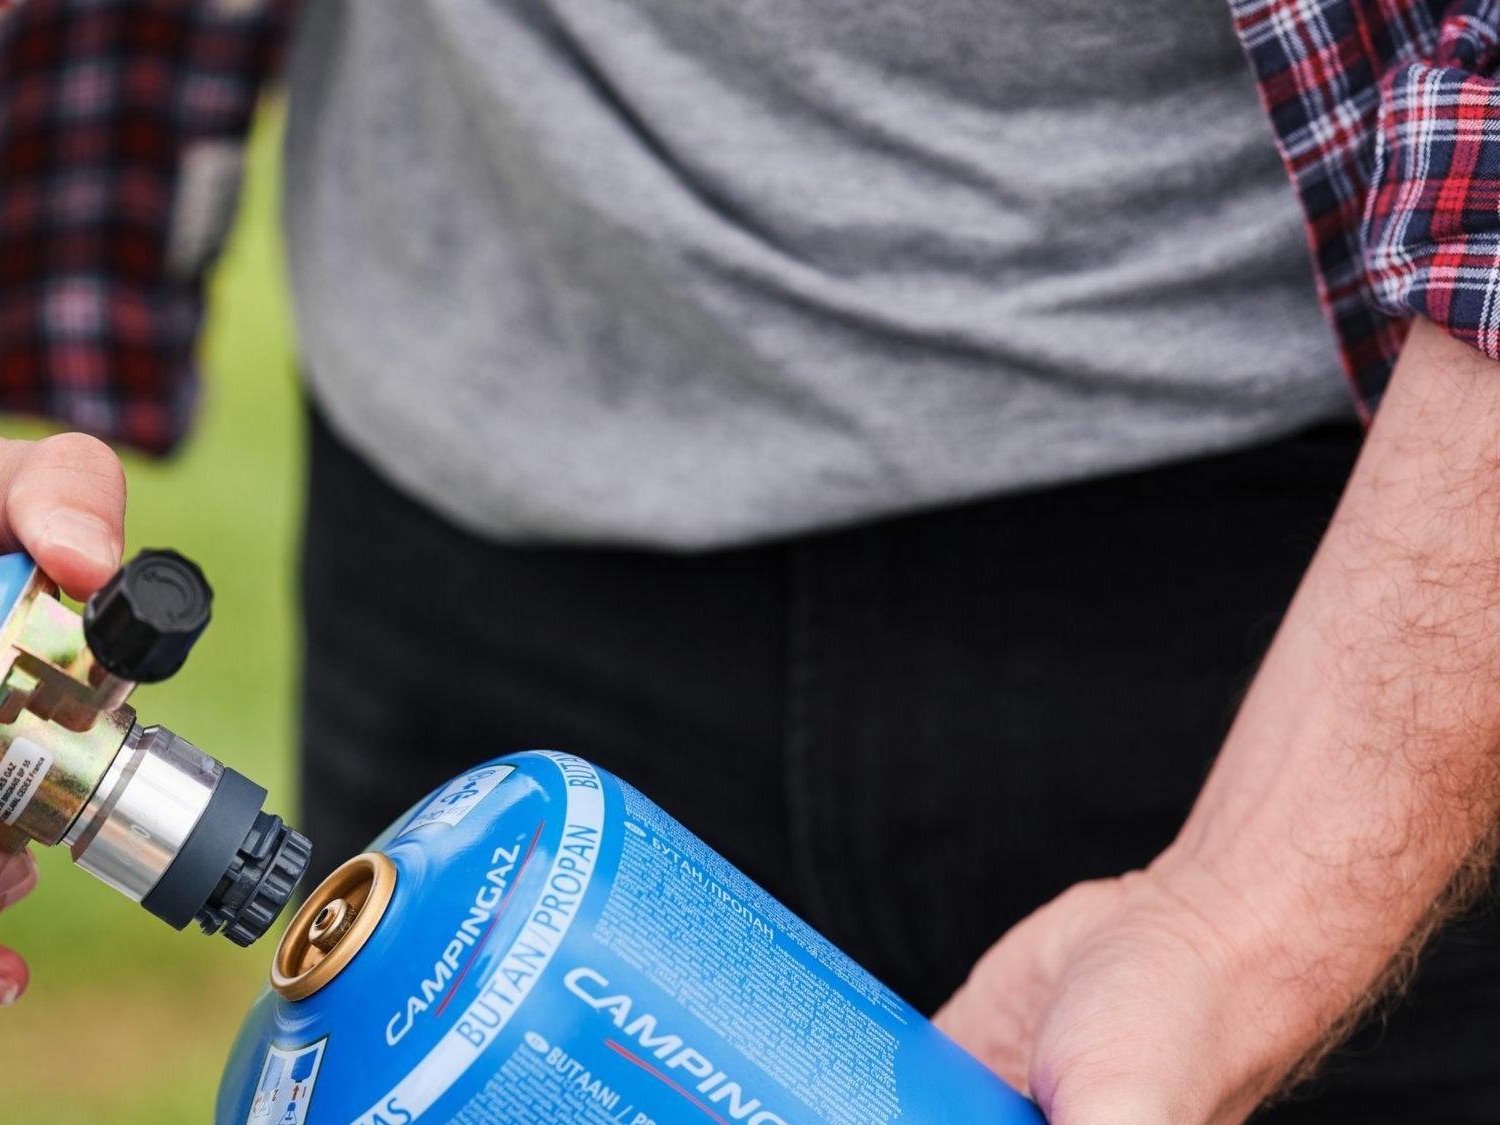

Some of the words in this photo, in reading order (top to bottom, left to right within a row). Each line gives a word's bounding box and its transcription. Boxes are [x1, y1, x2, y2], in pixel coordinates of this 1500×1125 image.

[3, 762, 16, 777] GAZ
[16, 776, 32, 797] CEDEX
[652, 837, 773, 940] БУТАН/ПРОПАН
[386, 844, 521, 1046] CAMPINGAZ
[457, 824, 599, 1047] BUTAN/PROPAN
[544, 1046, 620, 1110] BUTAANI
